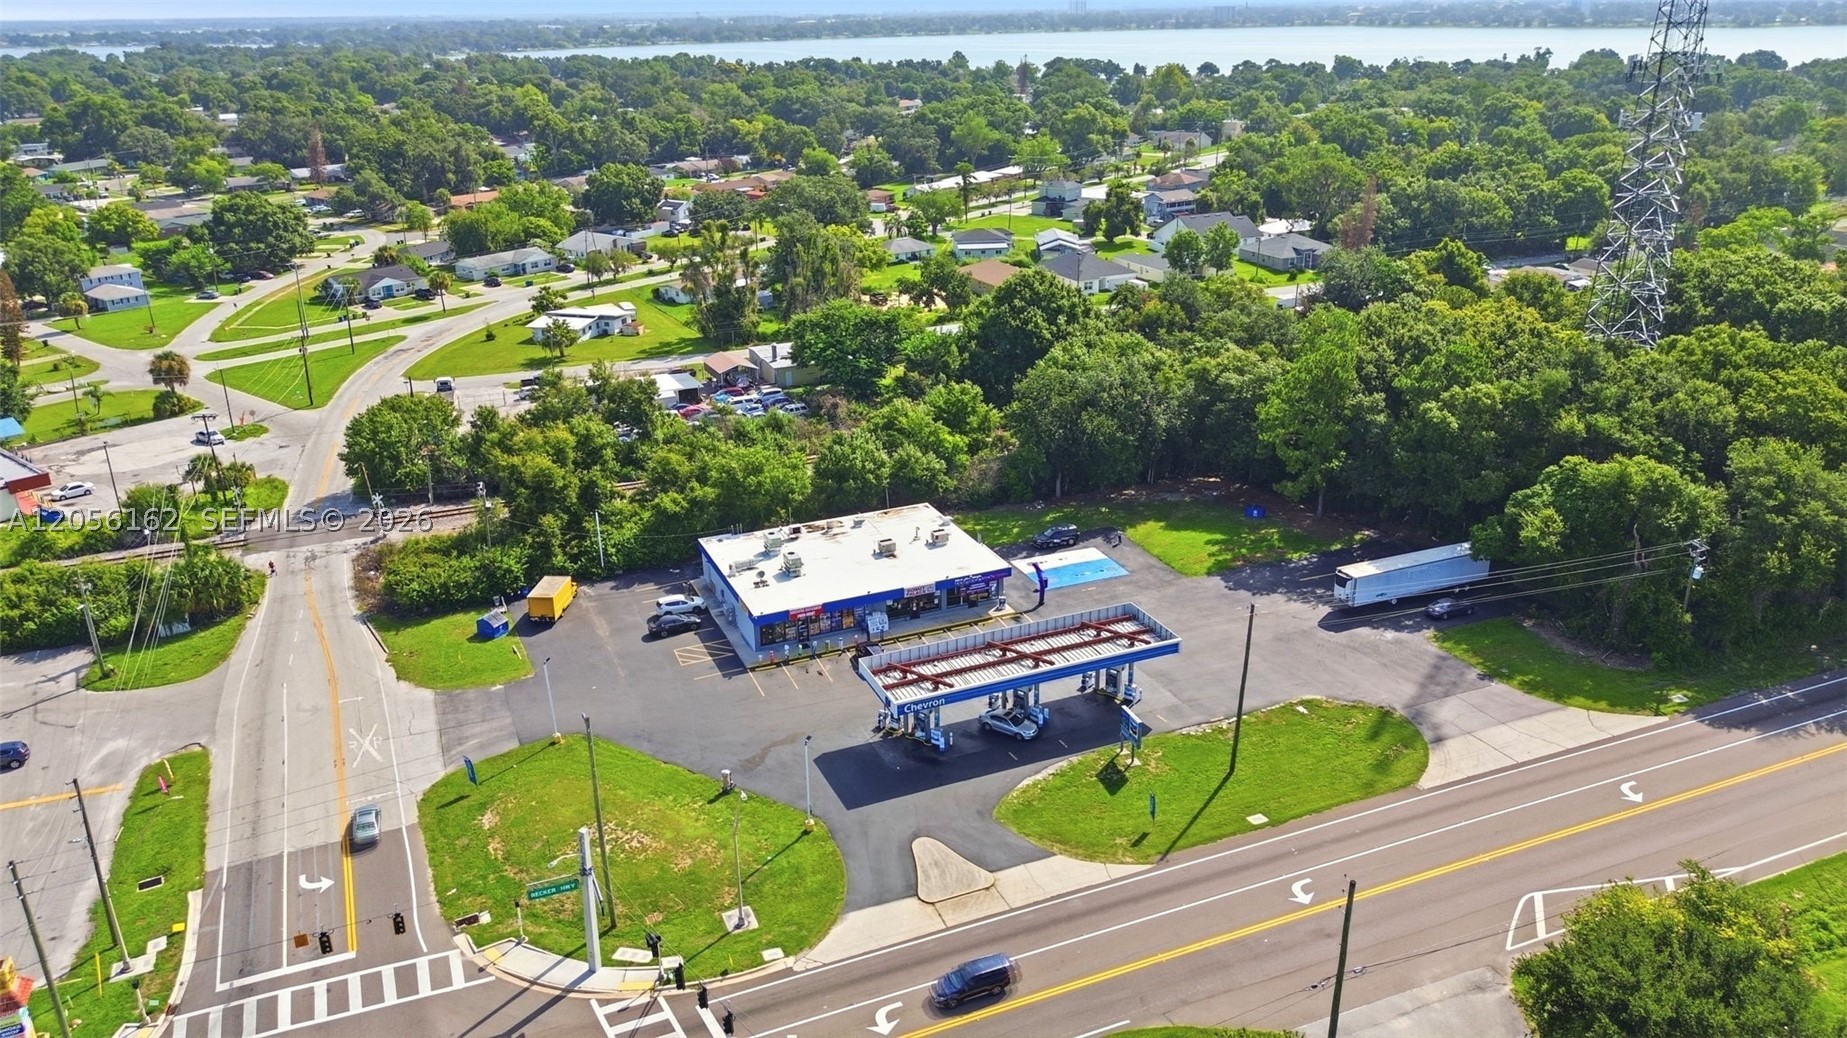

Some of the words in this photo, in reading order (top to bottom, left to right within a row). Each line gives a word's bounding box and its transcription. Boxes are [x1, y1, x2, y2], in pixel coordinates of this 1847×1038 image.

[904, 698, 945, 713] Chevron
[530, 887, 556, 898] RECKER
[560, 883, 576, 891] HWY
